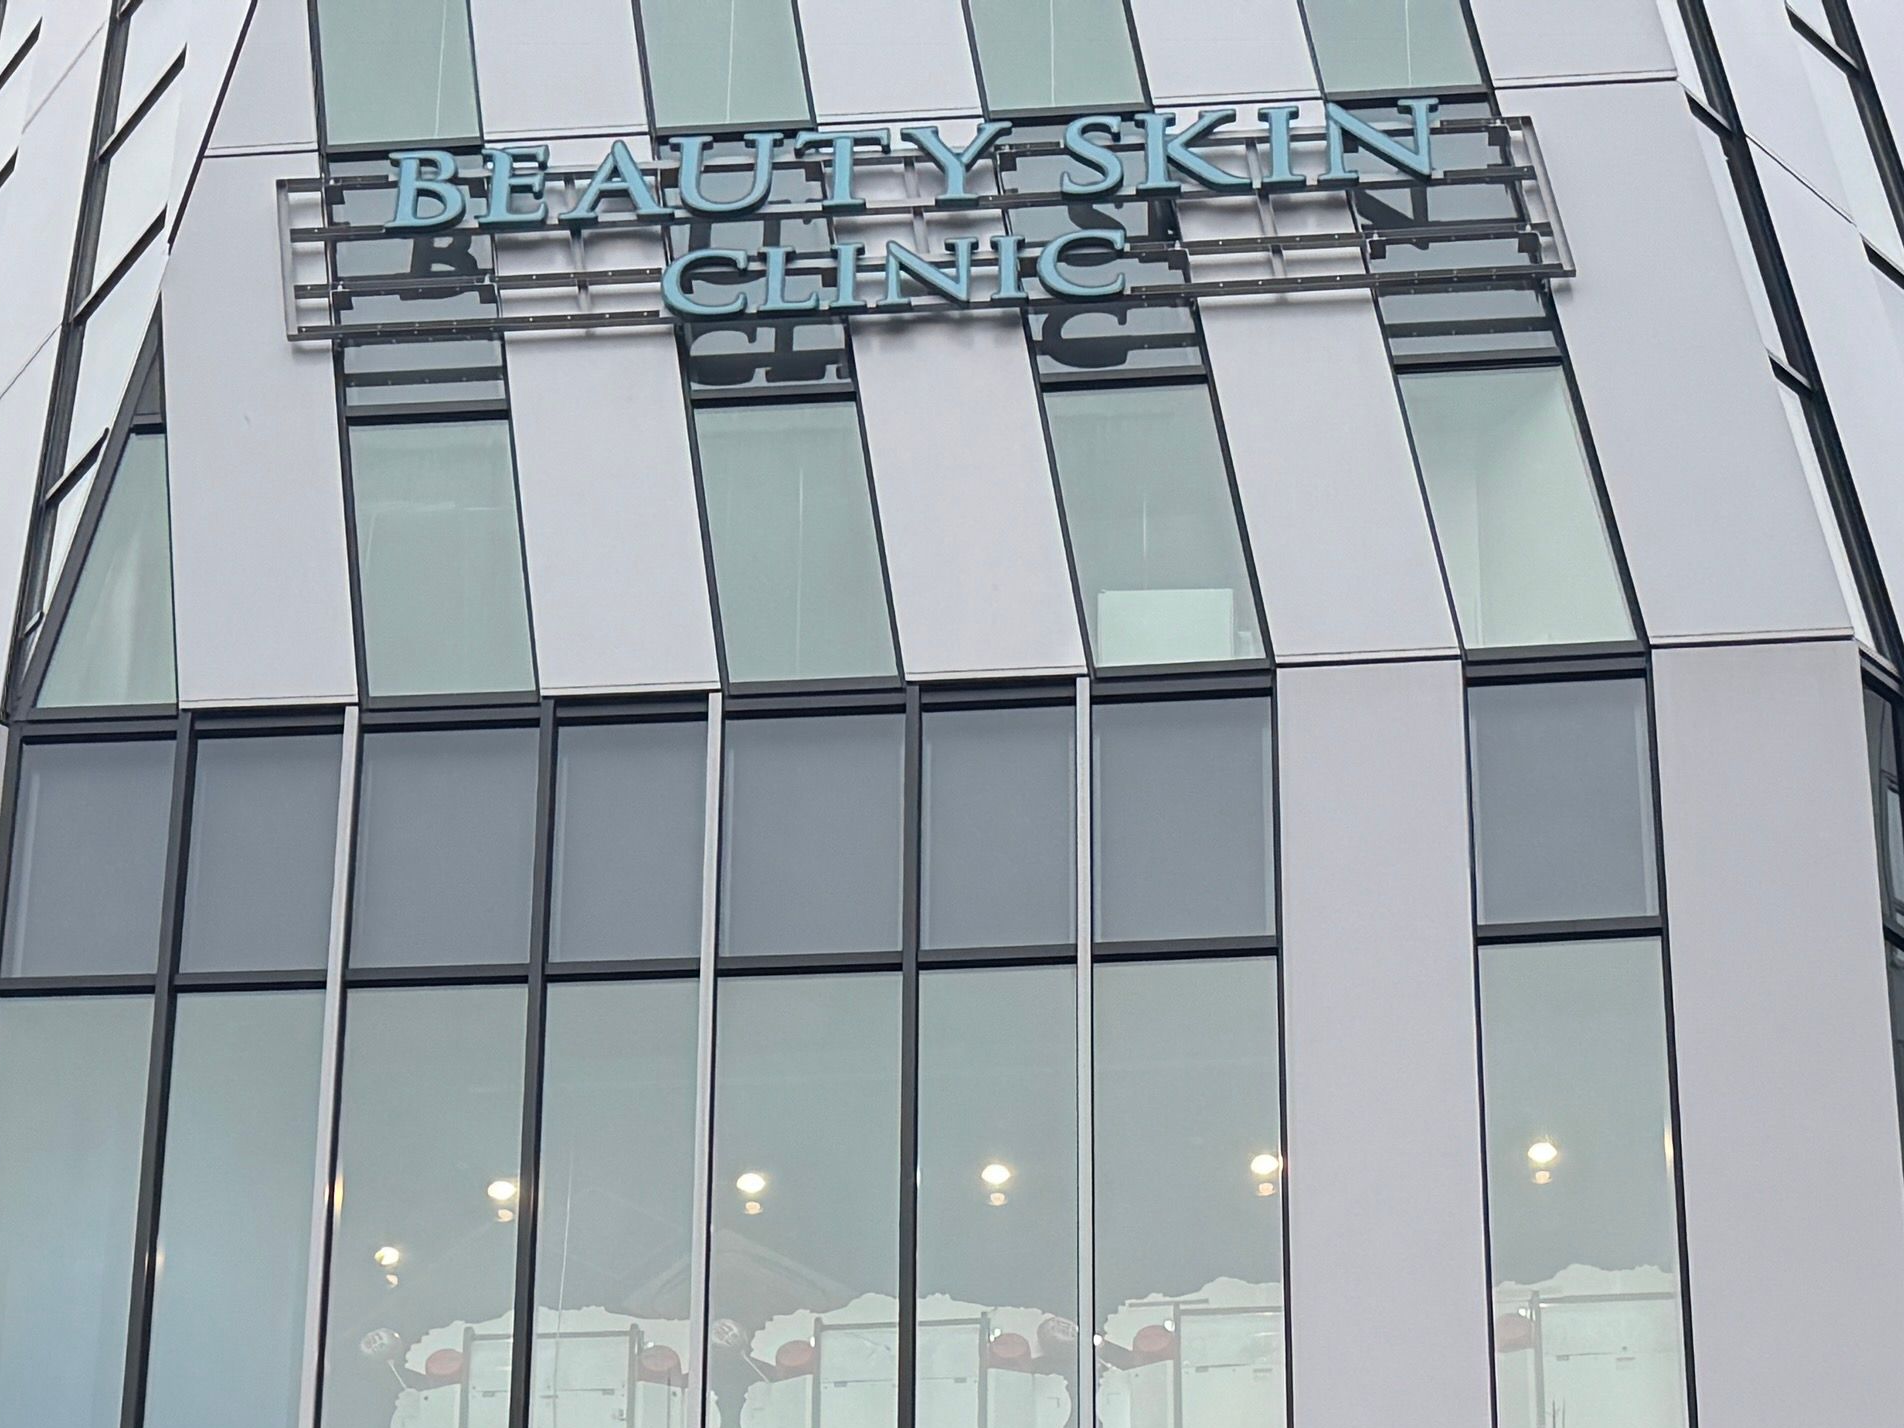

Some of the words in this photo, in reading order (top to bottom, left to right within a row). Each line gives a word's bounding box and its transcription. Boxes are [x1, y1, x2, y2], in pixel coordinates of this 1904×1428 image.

[385, 118, 1012, 232] BEAUTY
[1061, 96, 1440, 199] SKIN
[659, 227, 1128, 320] CLINIC
